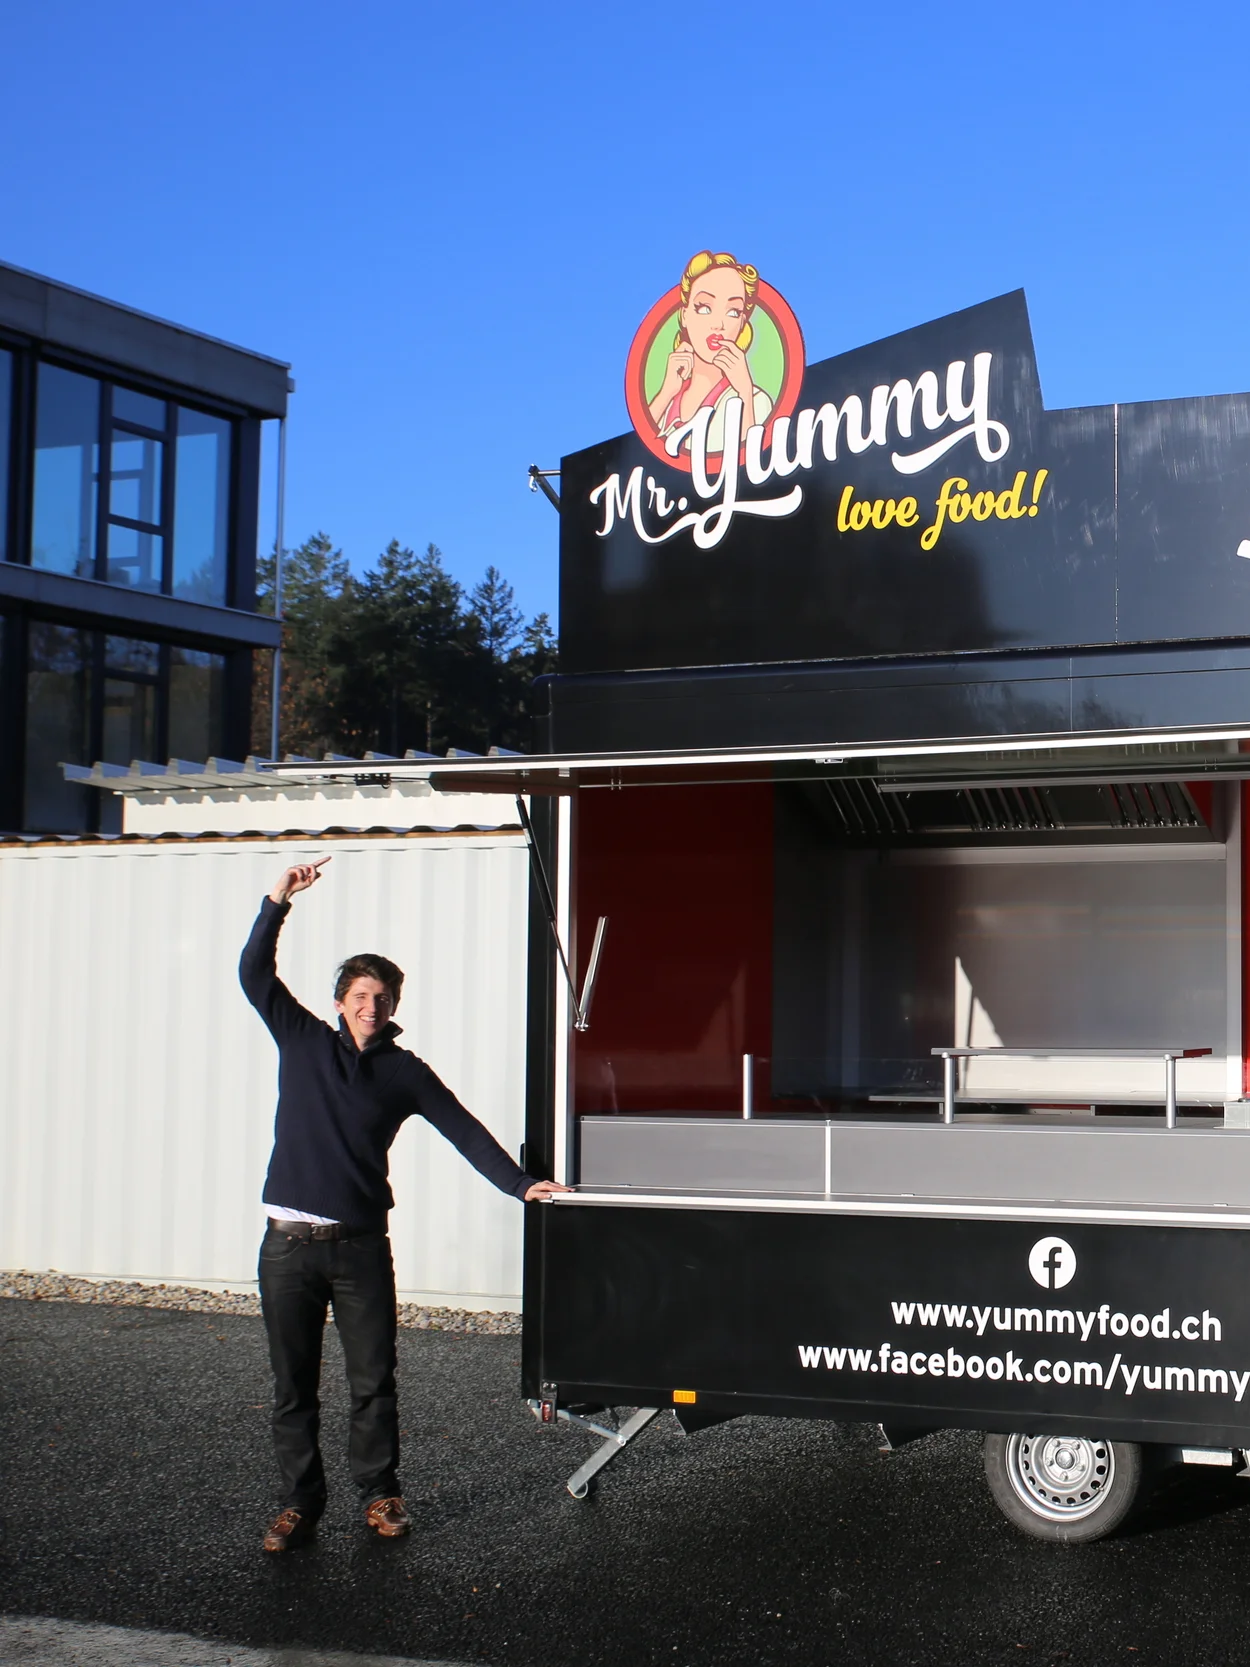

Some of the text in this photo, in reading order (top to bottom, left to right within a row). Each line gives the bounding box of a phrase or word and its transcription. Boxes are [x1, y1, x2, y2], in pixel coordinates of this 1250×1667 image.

[589, 352, 1010, 549] Mr. Yummy
[836, 468, 1049, 551] love food!
[891, 1300, 1222, 1342] www.yummyfood.ch
